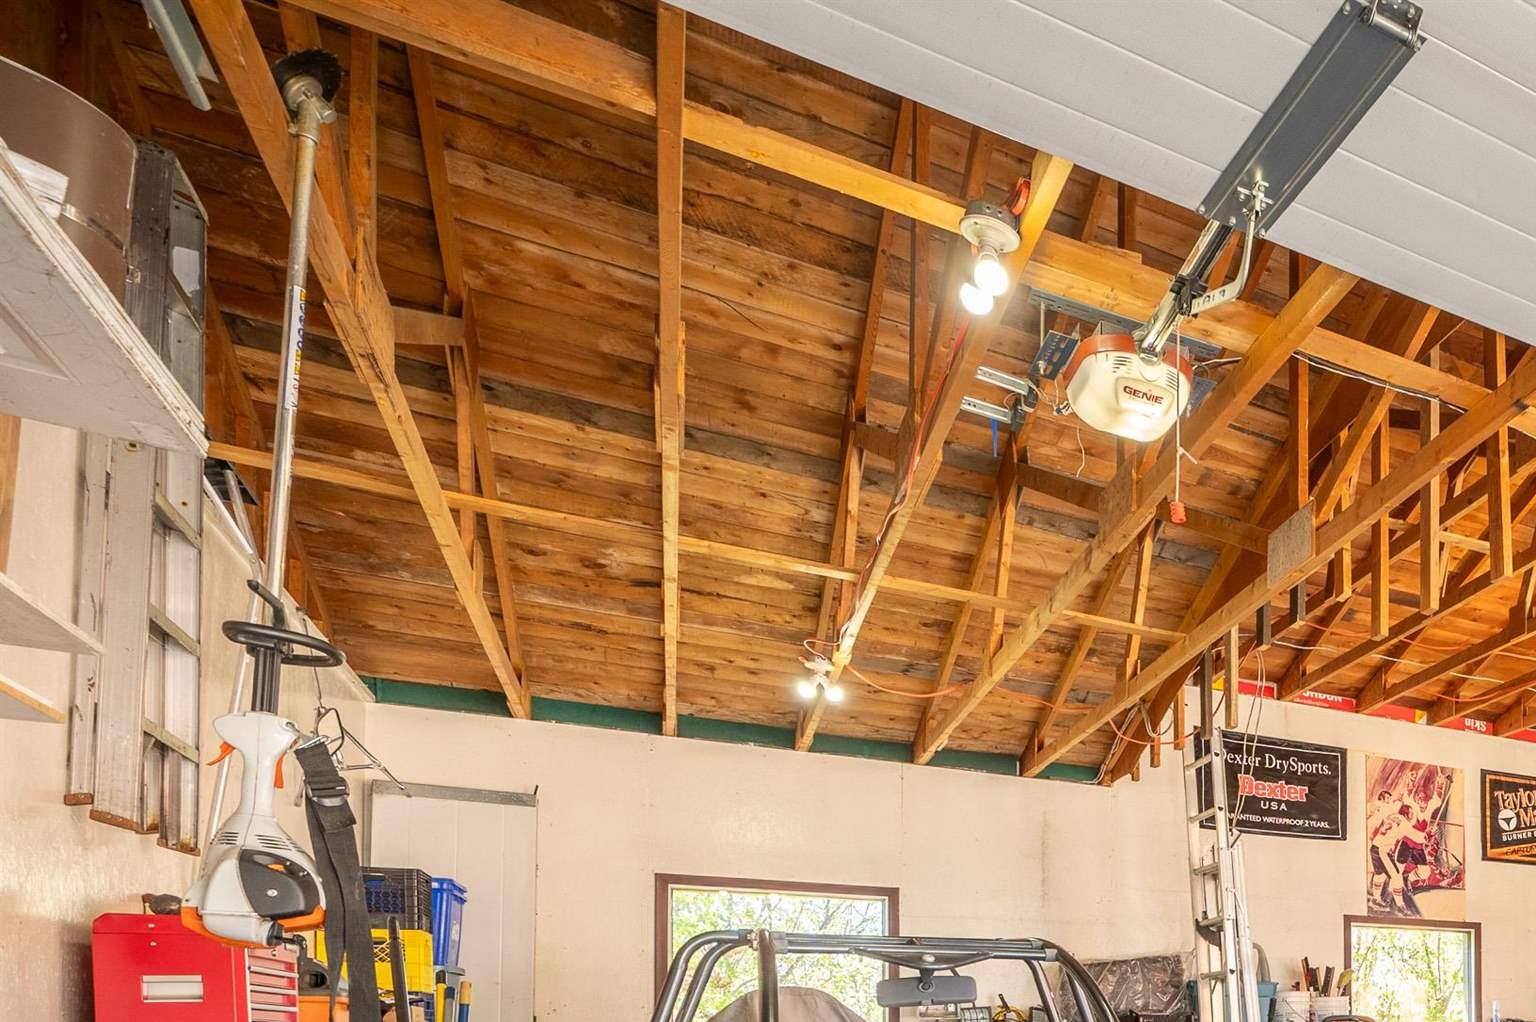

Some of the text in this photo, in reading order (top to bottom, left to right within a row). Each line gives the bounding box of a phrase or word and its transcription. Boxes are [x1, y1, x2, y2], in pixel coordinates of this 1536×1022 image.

[1123, 385, 1164, 405] GENIE
[1223, 750, 1332, 775] exter DrySports.
[1238, 774, 1308, 802] Dexter
[1260, 801, 1288, 811] USA
[1502, 831, 1531, 841] BURNER
